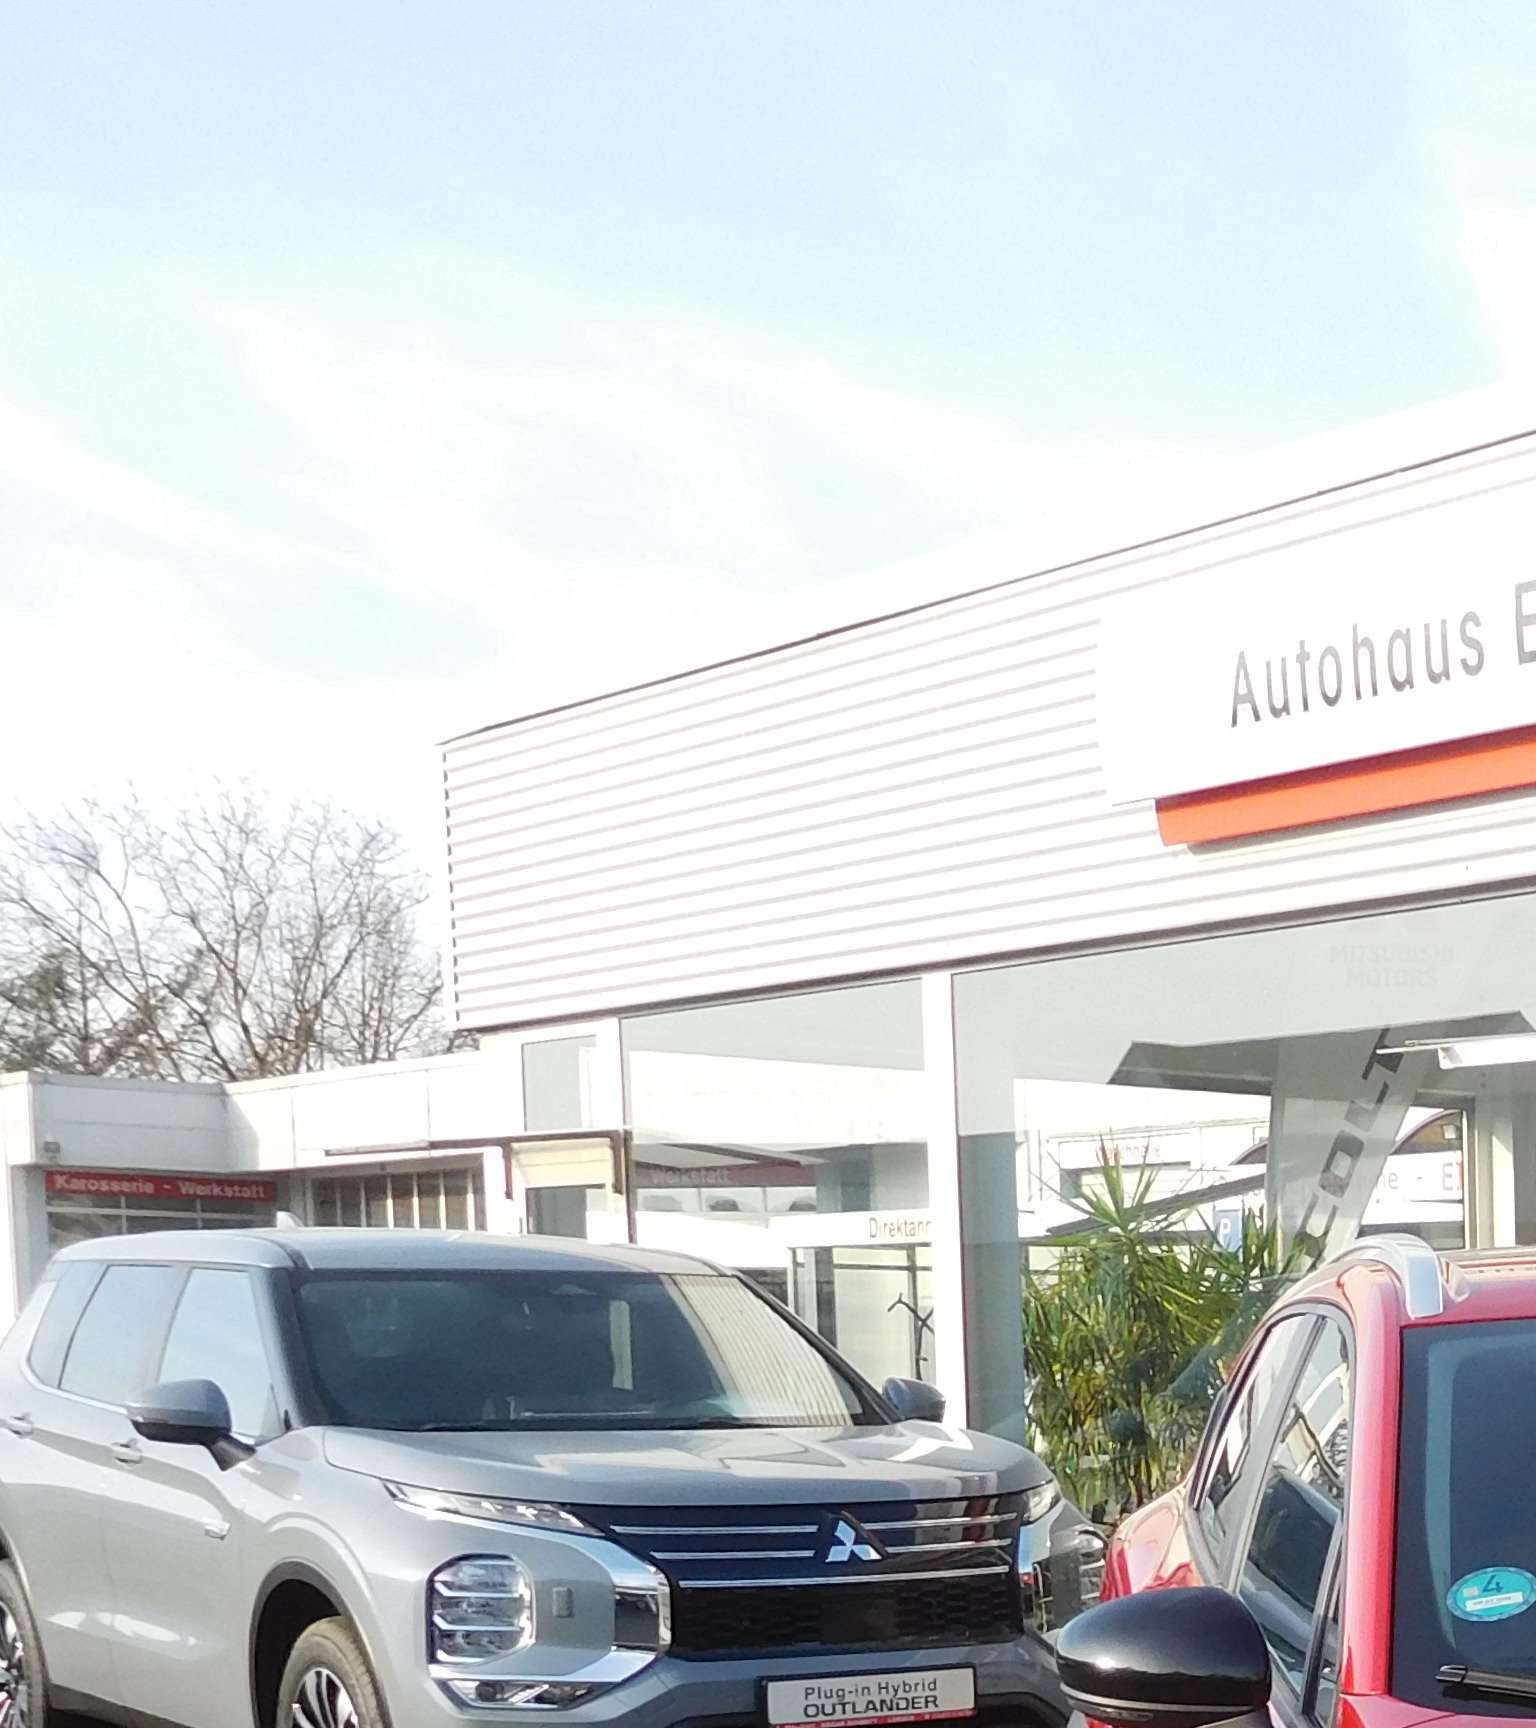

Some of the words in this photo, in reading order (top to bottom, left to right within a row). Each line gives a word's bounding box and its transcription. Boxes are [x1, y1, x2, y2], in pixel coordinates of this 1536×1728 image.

[1230, 609, 1485, 728] Autohaus
[54, 1174, 155, 1194] Karosserie
[178, 1179, 265, 1199] Werkstatt
[1482, 1574, 1504, 1593] 4
[804, 1683, 870, 1701] Plug-in
[877, 1678, 938, 1697] Hybrid
[803, 1695, 939, 1718] OUTLANDER
